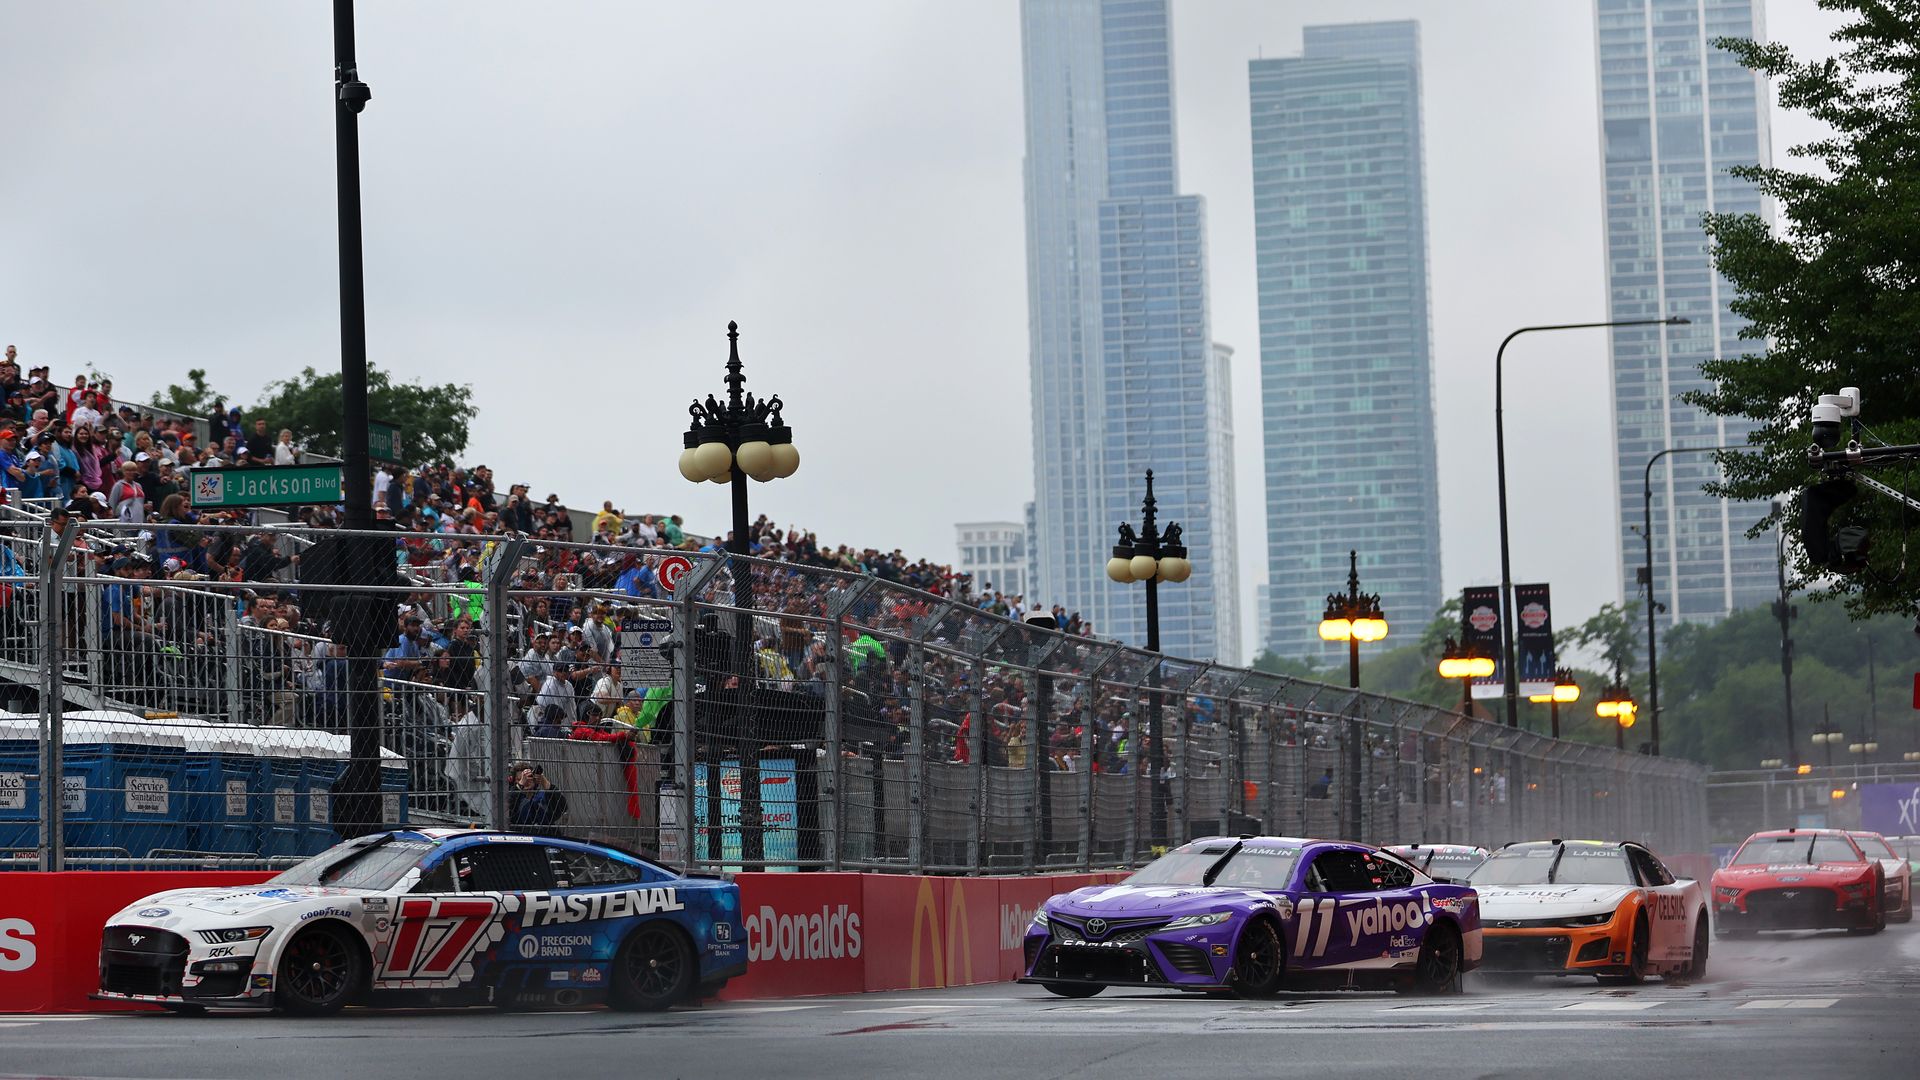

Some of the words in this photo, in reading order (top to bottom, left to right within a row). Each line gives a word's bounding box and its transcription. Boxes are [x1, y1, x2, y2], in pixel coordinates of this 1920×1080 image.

[227, 481, 232, 491] E
[237, 475, 310, 496] Jackson
[315, 477, 336, 489] Blvd
[131, 779, 164, 791] Service
[131, 792, 165, 802] Sanitation
[1239, 847, 1293, 857] HAMLIN
[300, 906, 352, 920] GOODYEAR
[521, 886, 685, 928] FASTENAL
[1347, 891, 1433, 947] yahoo!
[746, 904, 861, 962] cDonald's
[1294, 899, 1335, 957] 11
[382, 897, 496, 977] 17
[541, 935, 592, 946] PRECISION
[1390, 935, 1416, 947] FedEx
[1063, 940, 1128, 948] CAMRY
[209, 946, 235, 957] RFK
[541, 947, 572, 957] BRAND
